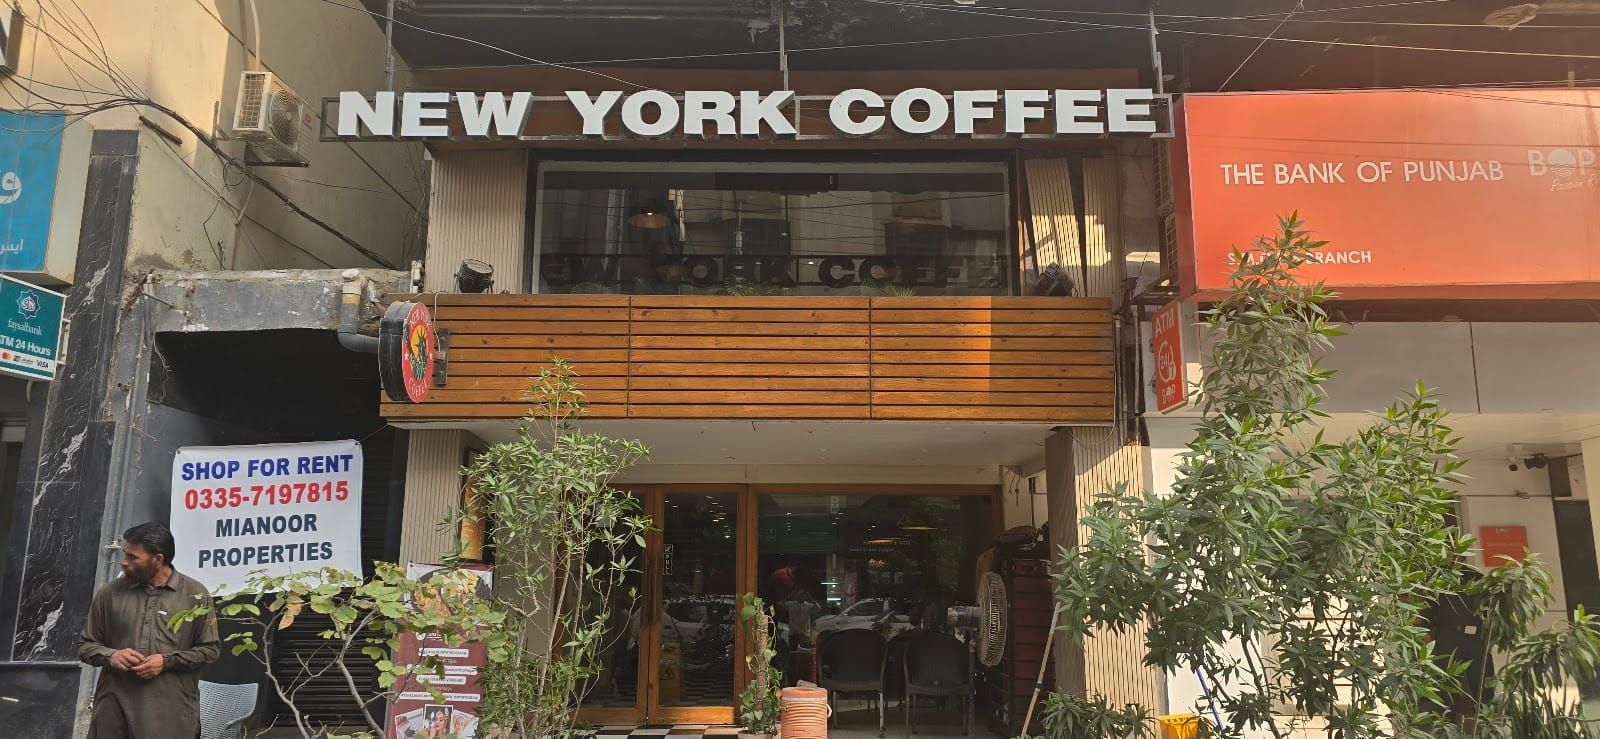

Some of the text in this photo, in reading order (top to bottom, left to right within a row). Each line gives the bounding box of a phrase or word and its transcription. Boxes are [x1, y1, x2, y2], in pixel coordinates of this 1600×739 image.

[337, 87, 1157, 137] NEW YORK COFFEE
[1220, 160, 1504, 185] THE BANK OF PUNJAB
[1155, 307, 1175, 337] ATM
[0, 334, 52, 357] TM 24 Hours
[181, 454, 353, 481] SHOP FOR RENT
[184, 481, 349, 510] 0335-7197815
[215, 513, 318, 538] MIANOOR
[198, 542, 333, 568] PROPERTIES
